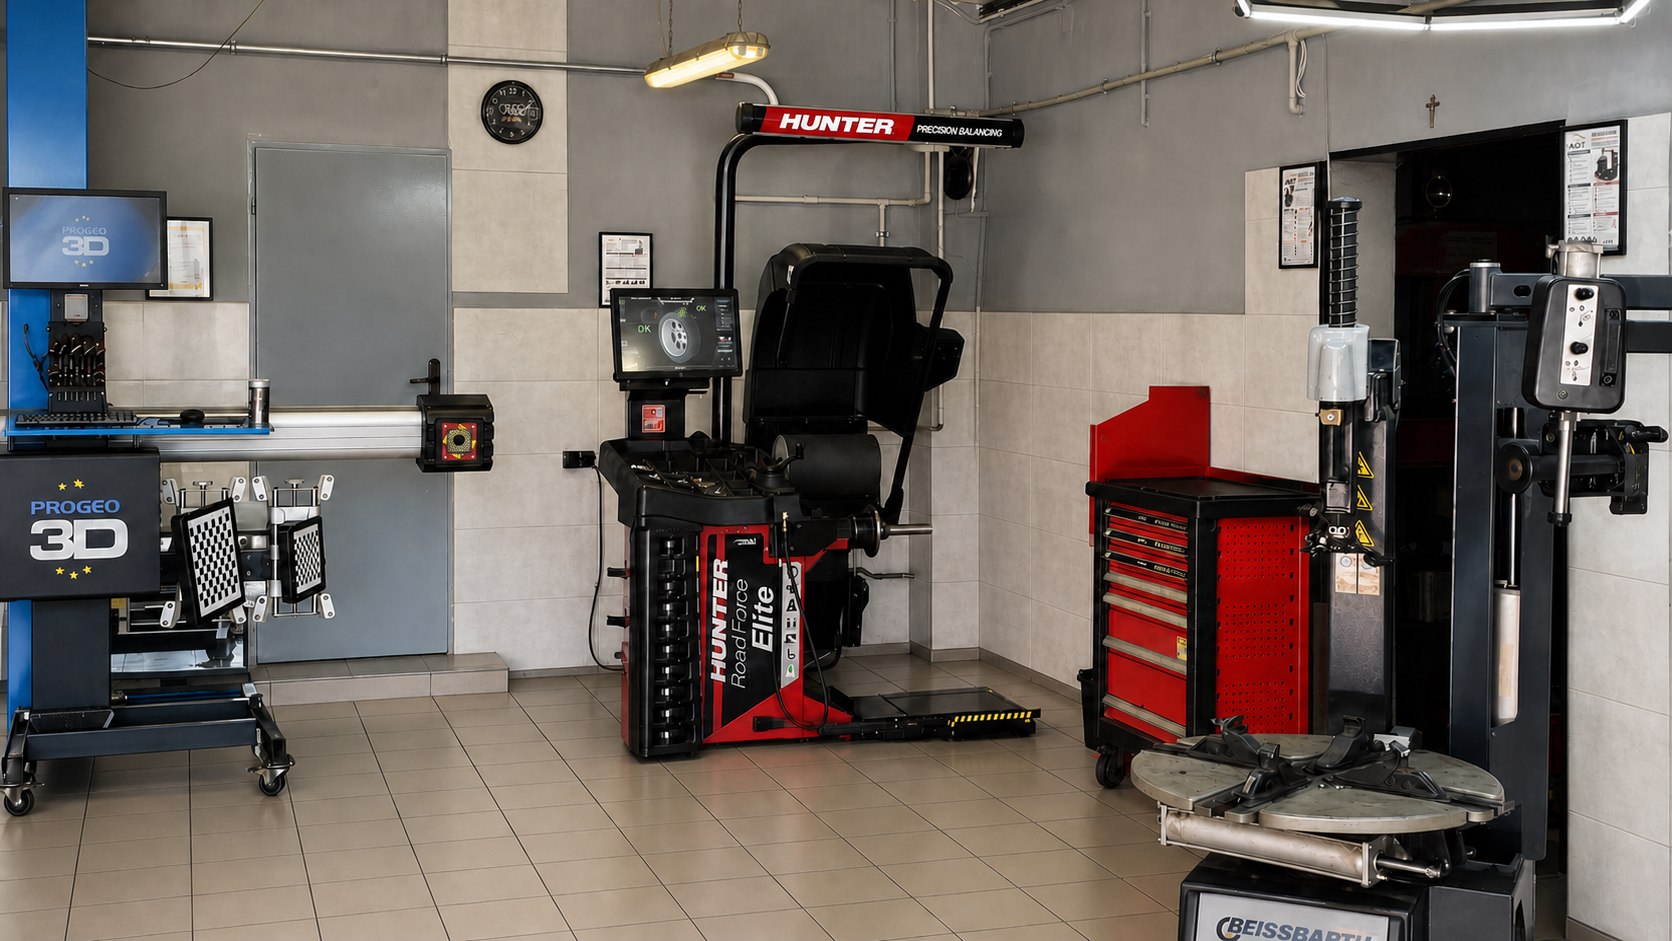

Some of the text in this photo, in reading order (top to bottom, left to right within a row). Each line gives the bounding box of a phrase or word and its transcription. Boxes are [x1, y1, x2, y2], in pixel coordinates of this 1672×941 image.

[779, 113, 1003, 137] HUNTER PRECISION BALANCING
[62, 226, 108, 235] PROGEO
[62, 236, 110, 256] 3D
[638, 324, 651, 333] OK
[31, 500, 121, 515] PROGEO
[30, 518, 129, 561] 3D
[710, 558, 729, 683] HUNTER
[752, 586, 775, 652] Elite
